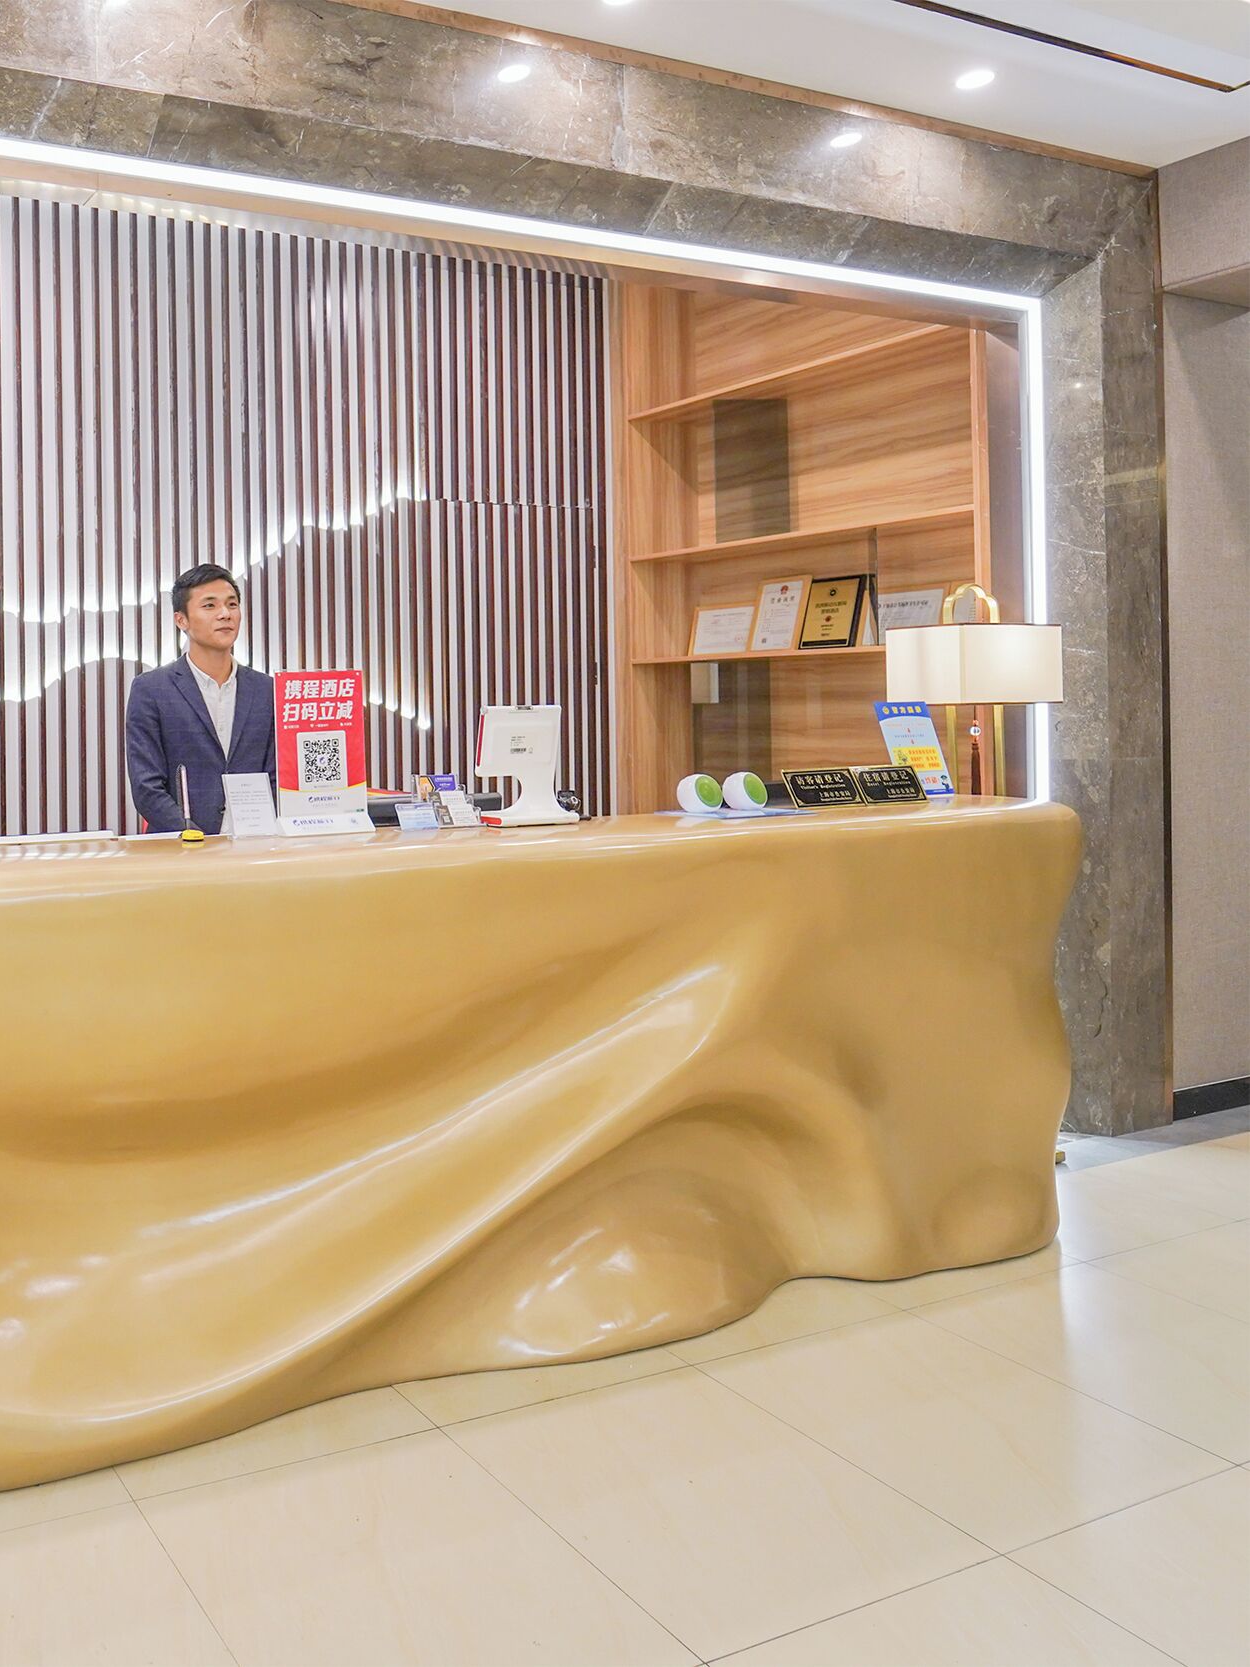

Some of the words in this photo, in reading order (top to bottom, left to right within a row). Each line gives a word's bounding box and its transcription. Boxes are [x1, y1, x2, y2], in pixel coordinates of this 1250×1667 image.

[284, 678, 355, 700] 携程酒店
[282, 700, 354, 722] 扫码立减
[863, 770, 909, 783] 住宿请登记
